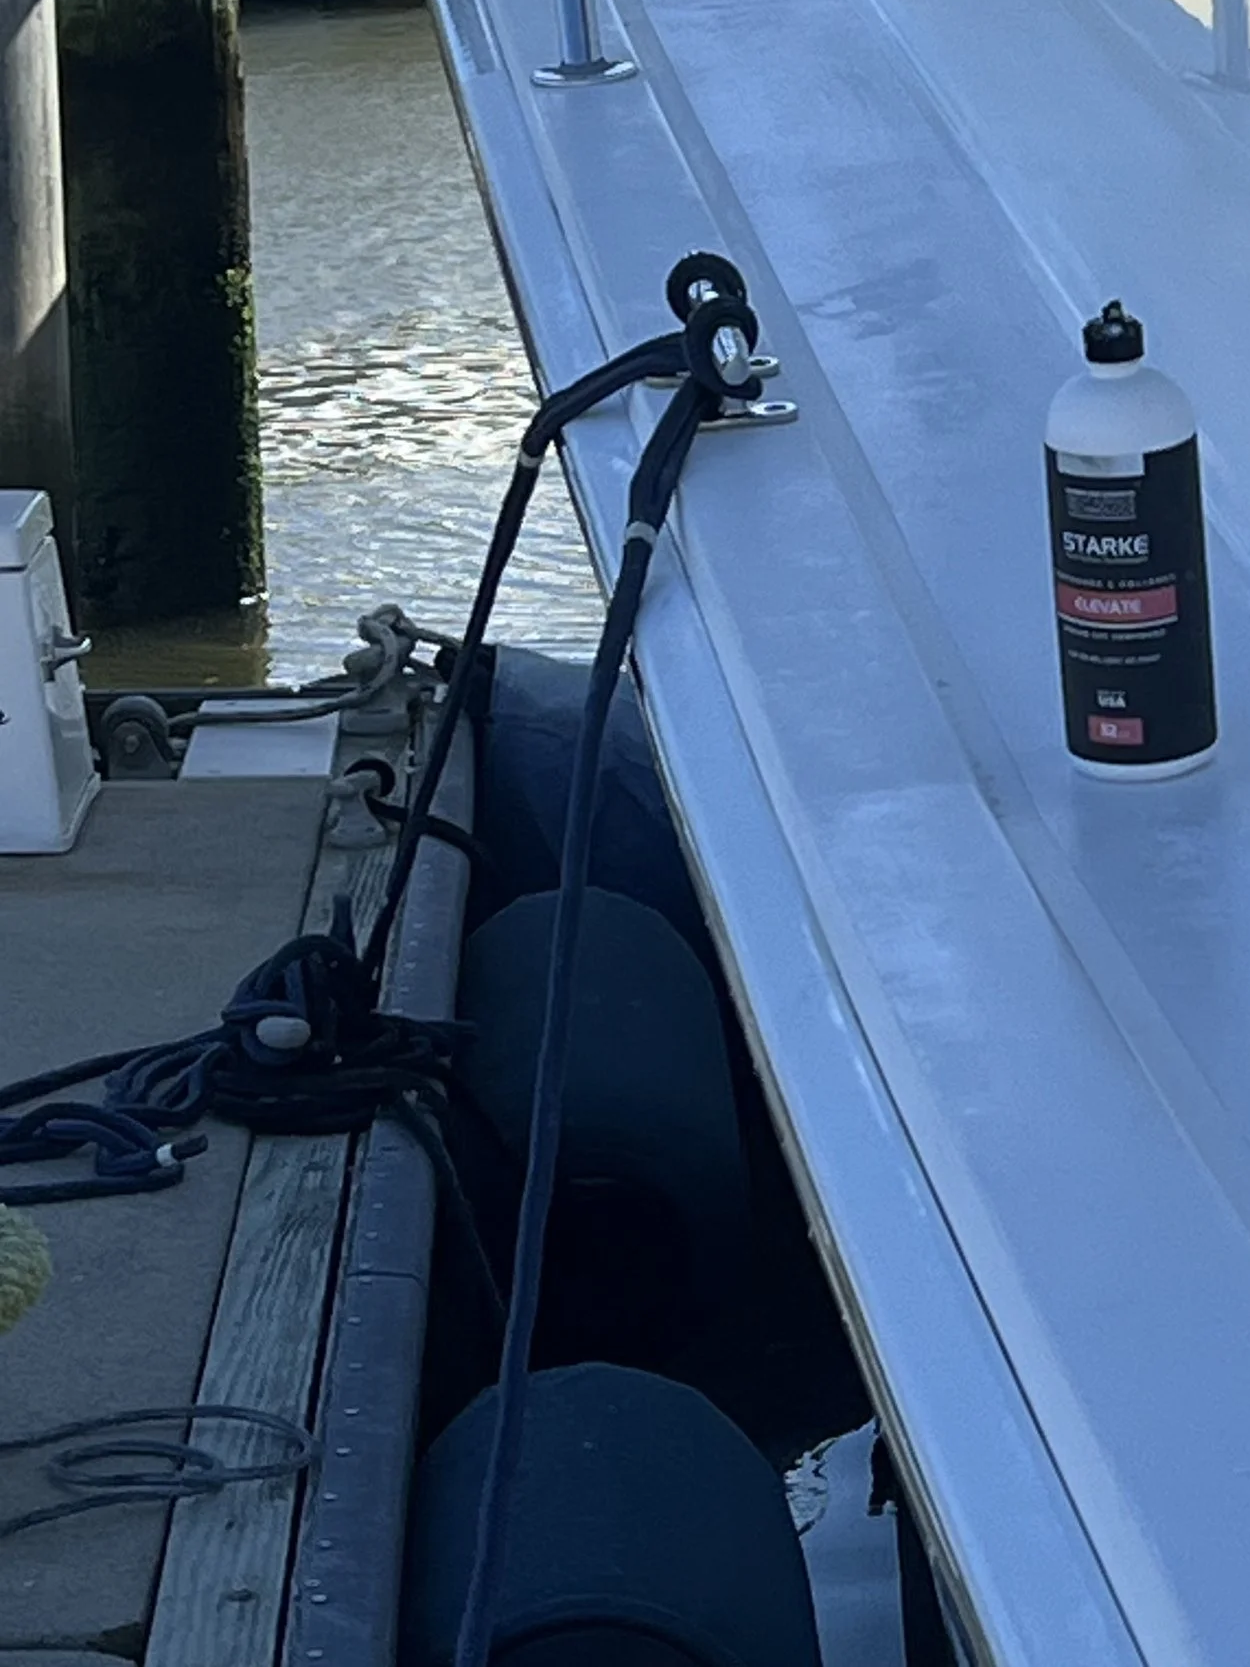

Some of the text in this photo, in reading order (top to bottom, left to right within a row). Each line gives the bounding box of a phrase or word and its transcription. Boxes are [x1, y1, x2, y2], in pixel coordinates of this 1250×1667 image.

[1063, 531, 1149, 556] STARKE
[1074, 596, 1141, 615] ELEVATE
[1098, 695, 1126, 708] USA
